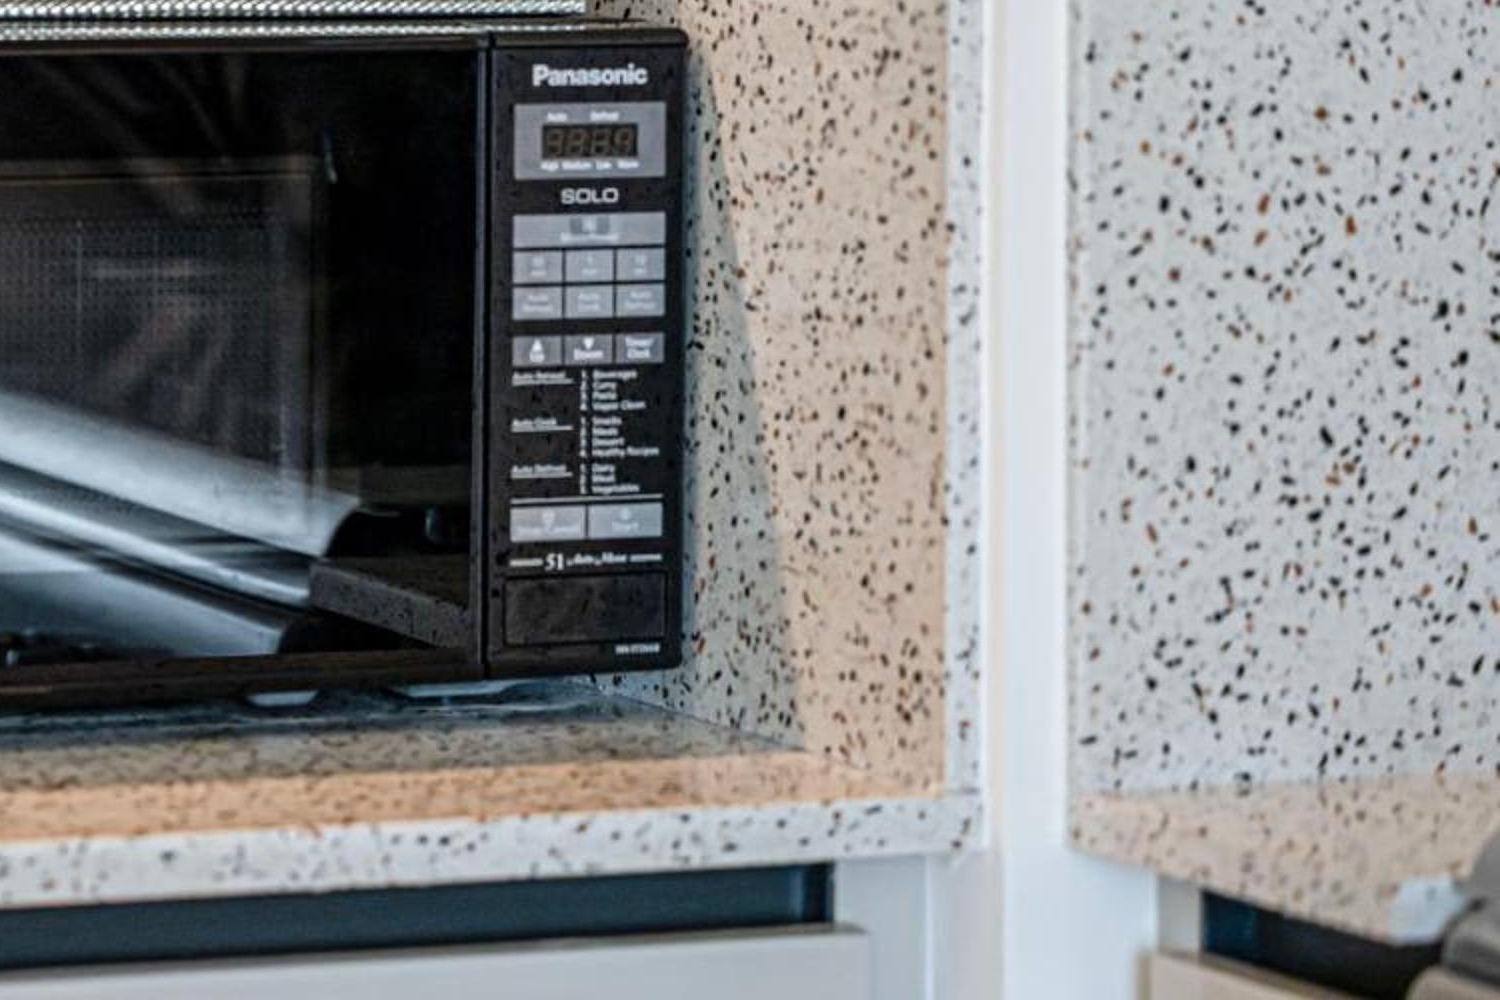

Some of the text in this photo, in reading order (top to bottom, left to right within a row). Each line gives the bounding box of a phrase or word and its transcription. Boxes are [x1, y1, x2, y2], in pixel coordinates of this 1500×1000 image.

[531, 63, 648, 87] Panasonic
[560, 186, 619, 205] SOLO
[545, 552, 565, 571] 51
